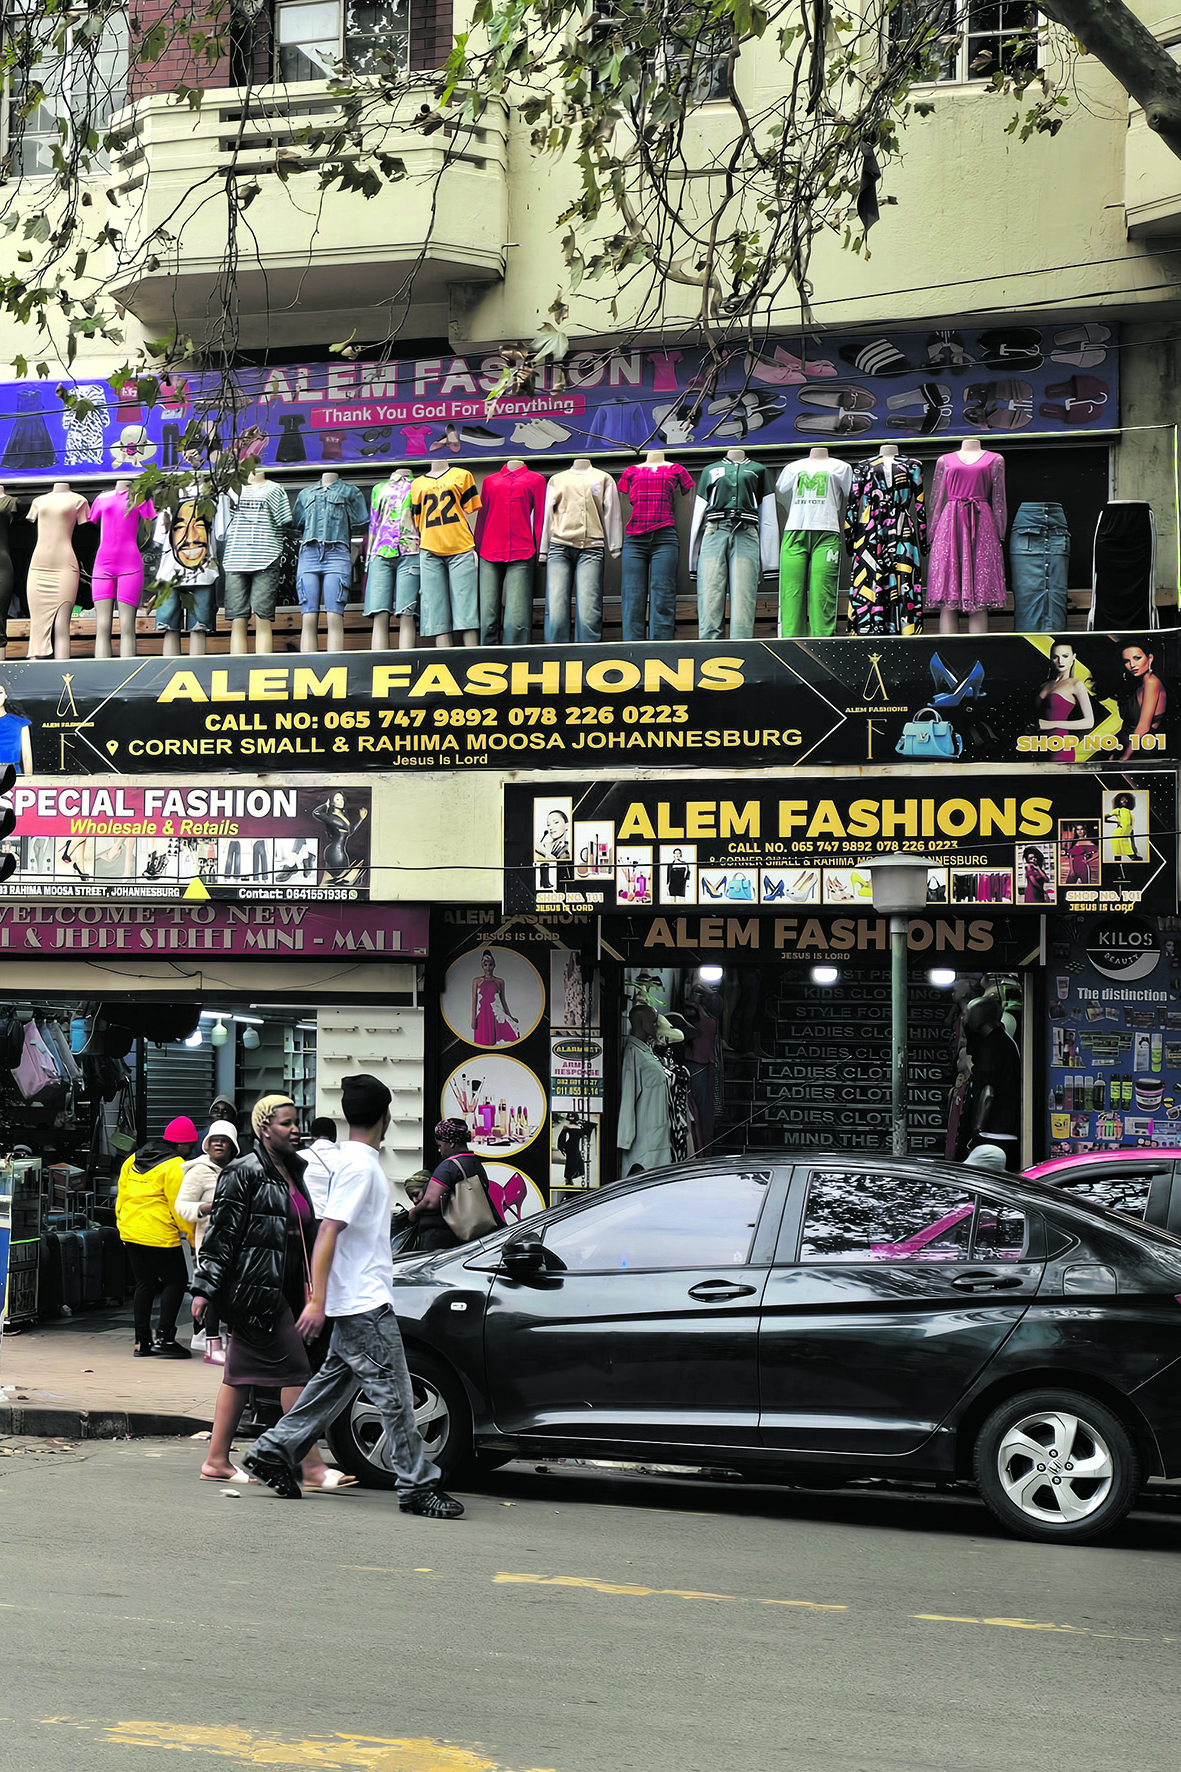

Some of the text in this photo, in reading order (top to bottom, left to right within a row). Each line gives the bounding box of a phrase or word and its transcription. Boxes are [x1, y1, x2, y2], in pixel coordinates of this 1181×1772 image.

[259, 361, 398, 404] ALEM
[323, 398, 574, 422] Thank You God For Everything
[423, 490, 460, 528] 22
[156, 657, 745, 703] ALEM FASHIONS
[205, 705, 689, 731] CALL NO: 065 747 9892 078 226 0223
[128, 729, 802, 756] CORNER SMALL & RAHIMA MOOSA JOHANNESBURG
[1016, 733, 1167, 753] SHOP NO. 101
[393, 753, 488, 766] Jesus Is Lord
[144, 788, 298, 818] FASHION
[617, 797, 1054, 839] ALEM FASHIONS
[69, 818, 240, 836] Wholesale & Retails
[728, 843, 761, 854] CALL
[765, 842, 788, 853] NO.
[791, 841, 813, 853] 065
[817, 841, 839, 852] 747
[842, 841, 873, 852] 9892
[876, 840, 900, 851] 078
[902, 840, 925, 851] 226
[9, 886, 43, 895] RAHIMA
[44, 886, 74, 896] MOOSA
[111, 887, 180, 898] JOHANNESBURG
[239, 887, 283, 900] Contact:
[1066, 891, 1098, 902] SHOP
[571, 904, 594, 912] LORD
[1069, 903, 1098, 912] JESUS
[1099, 903, 1108, 912] IS
[167, 906, 216, 925] TO
[227, 906, 309, 925] NEW
[443, 909, 495, 924] ALEM
[23, 928, 43, 948] &
[50, 927, 133, 949] JEPPE
[139, 928, 237, 949] STREET
[244, 928, 304, 950] MINI
[332, 929, 409, 952] MALL
[476, 932, 512, 941] JESUS
[515, 932, 525, 941] IS
[644, 917, 995, 952] ALEM FASHONS
[1099, 931, 1153, 946] KILOS
[781, 952, 851, 961] JESUS IS LORD
[1104, 952, 1139, 965] BEAUTY
[804, 987, 845, 999] KIDS
[1077, 987, 1168, 1001] The distinction
[796, 1006, 852, 1018] STYLE
[791, 1025, 855, 1037] LADIES
[785, 1045, 850, 1058] LADIES
[768, 1065, 943, 1080] LADIES CLOTING
[766, 1085, 943, 1101] LADIES CLOTING
[764, 1108, 943, 1126] LADIES CLOTING
[784, 1132, 879, 1147] MIND THE
